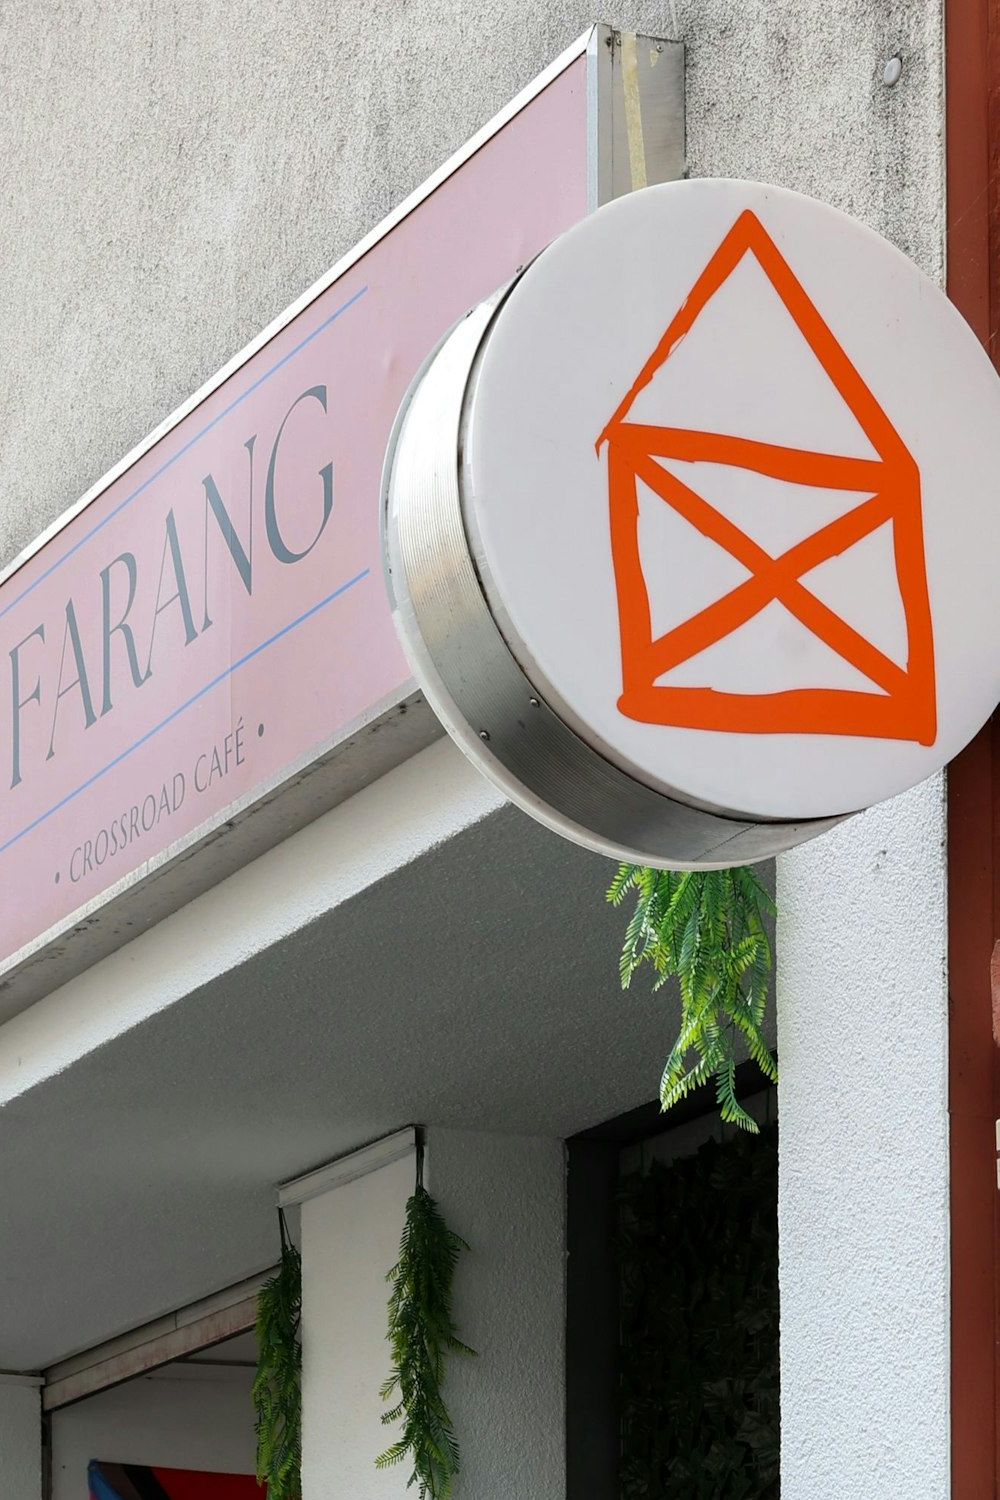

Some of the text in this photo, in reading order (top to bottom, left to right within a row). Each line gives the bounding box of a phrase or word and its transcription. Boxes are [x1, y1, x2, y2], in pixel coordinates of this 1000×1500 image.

[9, 385, 333, 790] FARANG
[69, 717, 247, 883] CROSSROAD CAFÉ
